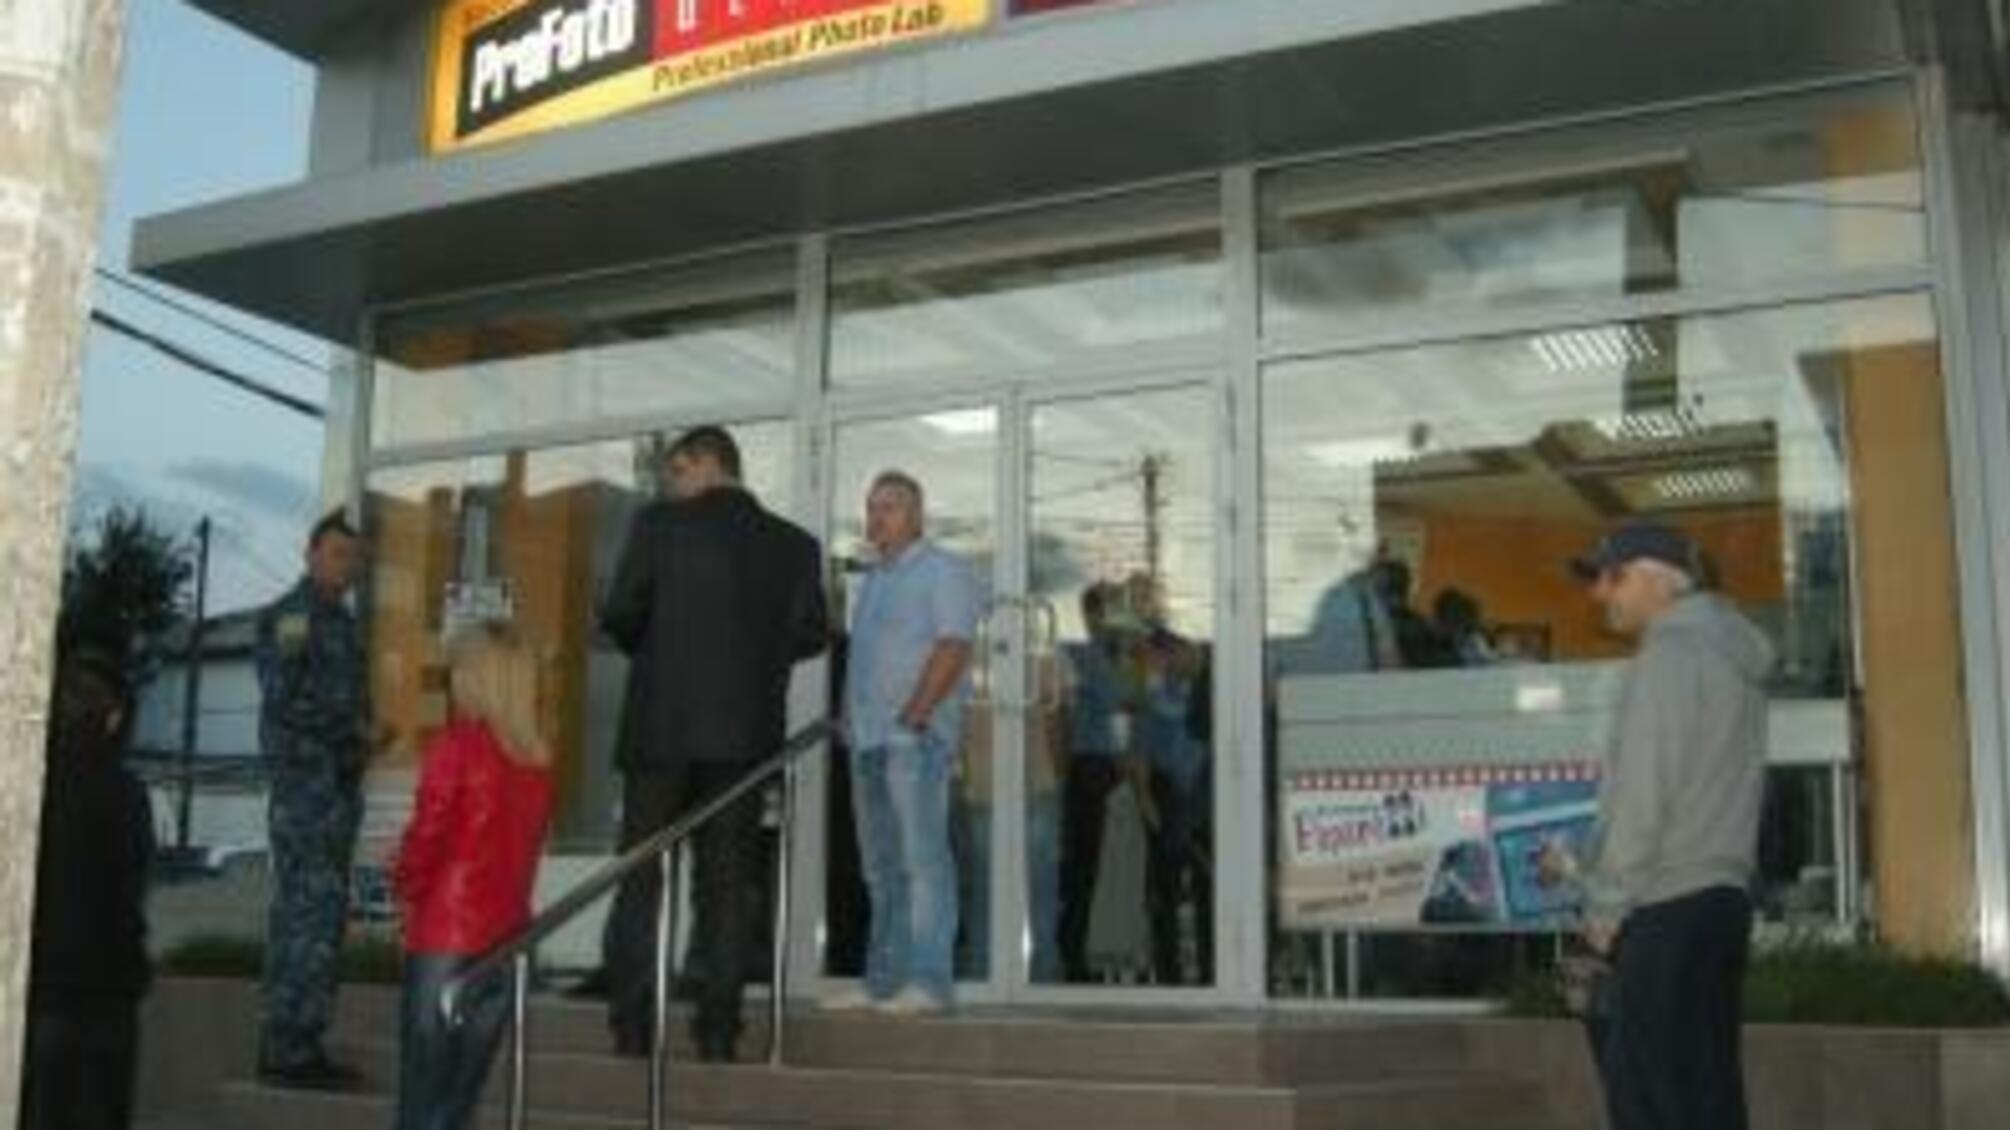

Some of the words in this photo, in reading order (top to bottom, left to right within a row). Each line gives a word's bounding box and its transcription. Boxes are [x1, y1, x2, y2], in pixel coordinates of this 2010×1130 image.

[469, 0, 636, 112] ProFoto
[652, 28, 804, 92] Professional
[808, 16, 889, 50] Photo
[890, 2, 945, 34] Lab
